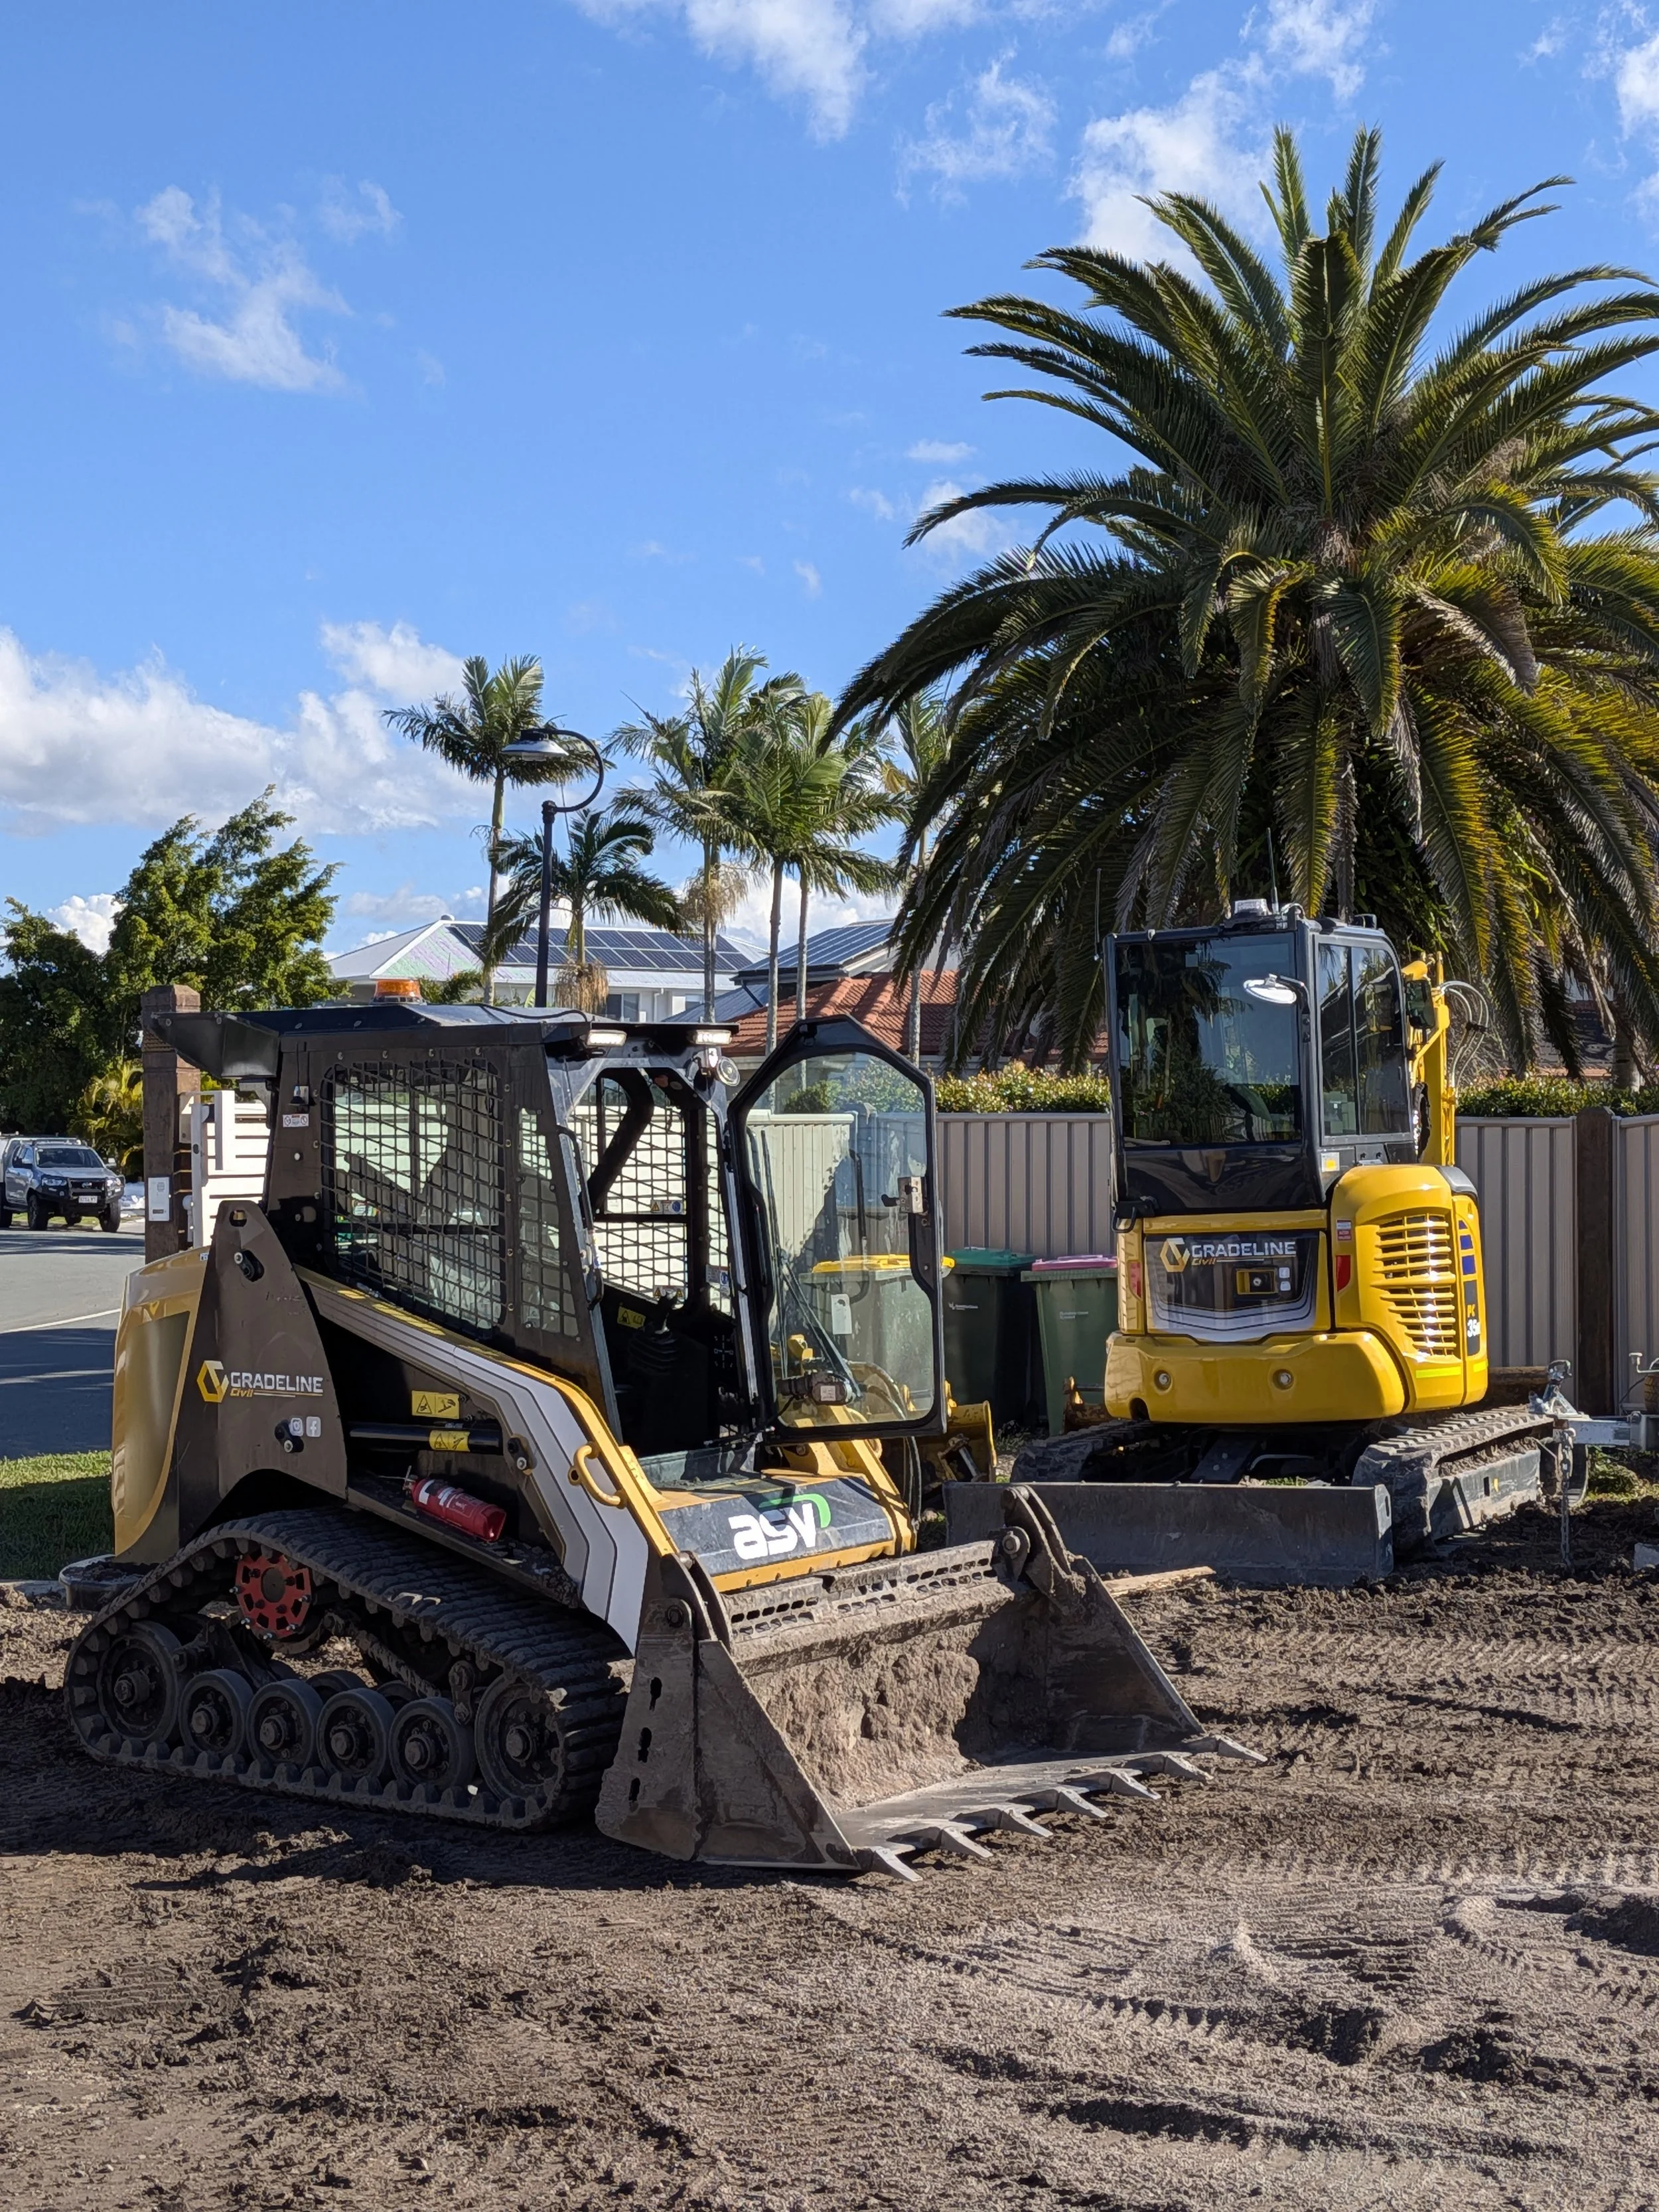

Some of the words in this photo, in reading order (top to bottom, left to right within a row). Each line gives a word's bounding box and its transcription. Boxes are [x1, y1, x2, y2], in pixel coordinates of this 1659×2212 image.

[1191, 1241, 1297, 1258] GRADELINE
[230, 1372, 324, 1393] GRADELINE
[230, 1388, 253, 1397] Civil
